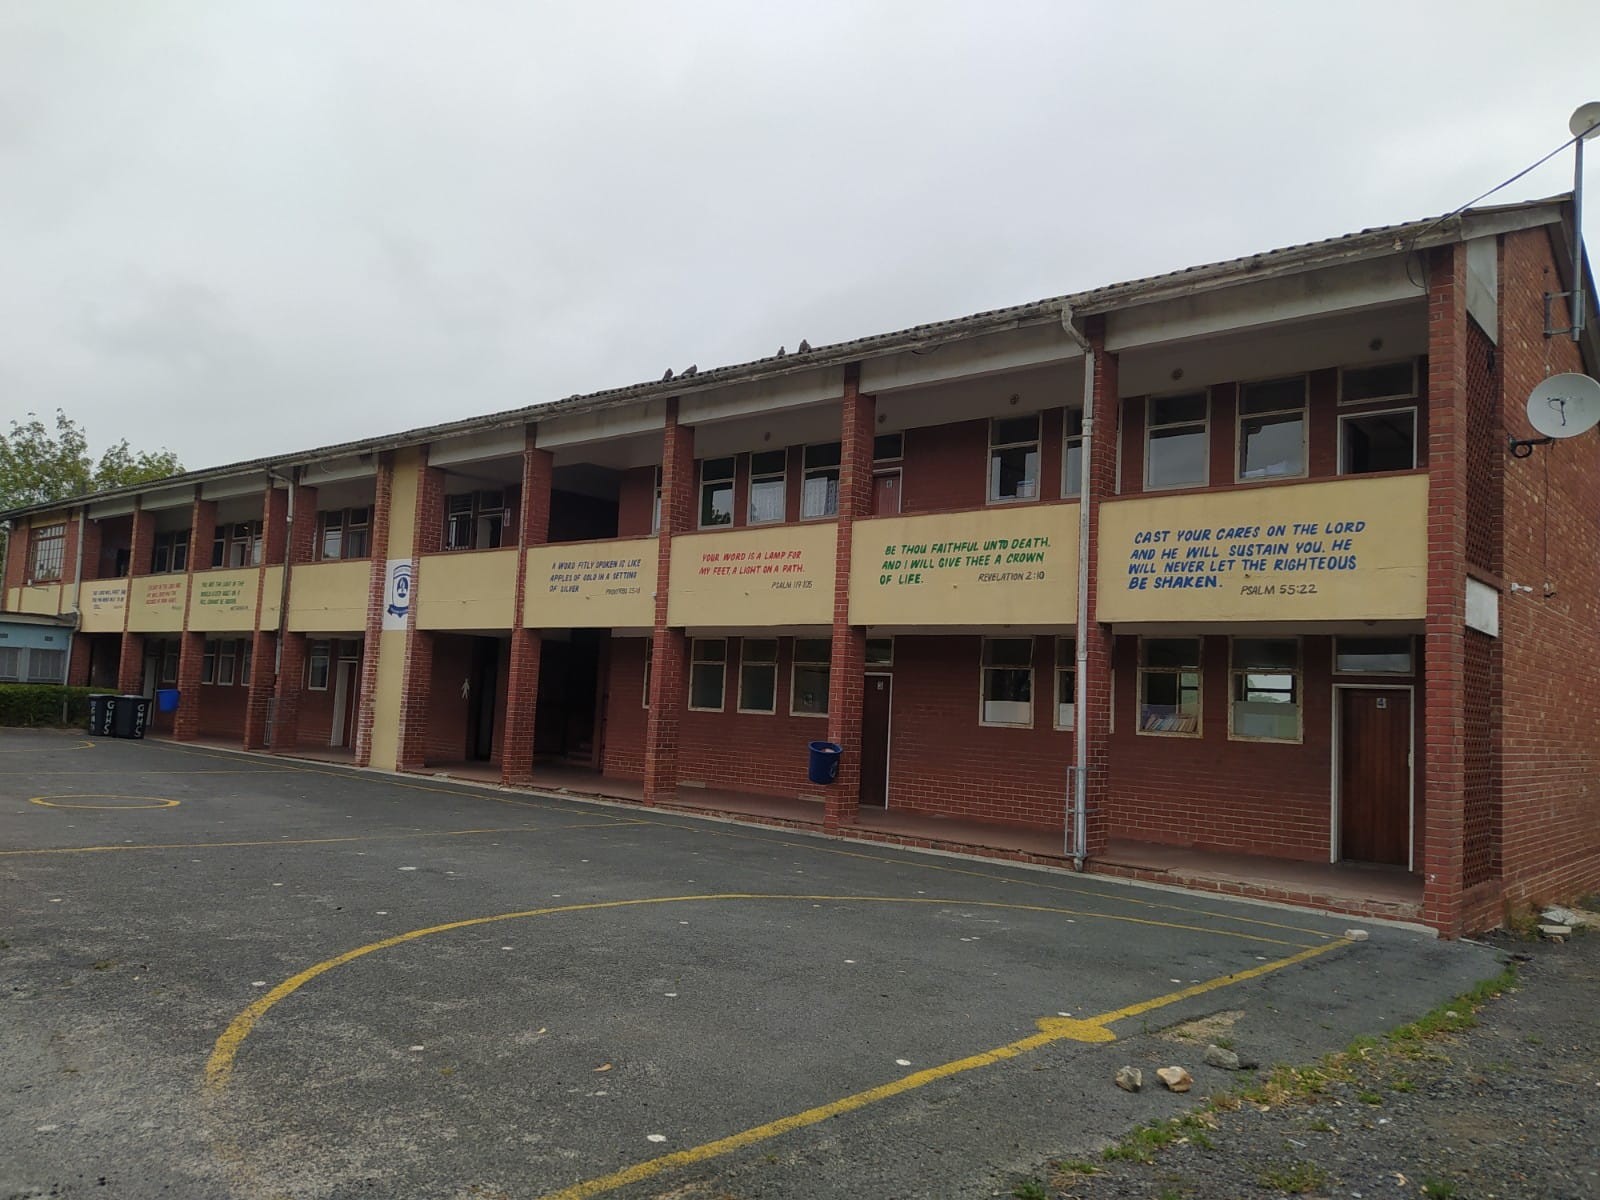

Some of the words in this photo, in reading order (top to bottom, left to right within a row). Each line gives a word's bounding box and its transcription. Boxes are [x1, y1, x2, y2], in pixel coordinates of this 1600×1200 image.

[1135, 530, 1170, 544] CAST
[1178, 529, 1210, 541] YOUR
[1216, 526, 1260, 540] CARES
[1267, 525, 1286, 537] ON
[1293, 524, 1318, 535] THE
[1325, 521, 1366, 533] LORD
[885, 546, 896, 555] BE
[901, 545, 926, 554] THOU
[931, 542, 978, 553] FAITHFUL
[983, 539, 1008, 550] UNTO
[1130, 549, 1156, 560] AND
[1162, 548, 1179, 559] HE
[1186, 546, 1219, 558] WILL
[1229, 543, 1289, 556] SUSTAIN
[1332, 539, 1352, 551] HE
[702, 553, 719, 562] YOUR
[748, 552, 755, 560] IS
[765, 551, 785, 559] LAMP
[787, 551, 801, 559] FOR
[882, 560, 901, 569] AND
[904, 560, 907, 569] I
[910, 558, 934, 569] WILL
[938, 557, 961, 568] GIVE
[965, 555, 990, 566] THEE
[995, 555, 1001, 564] A
[1006, 552, 1044, 564] CROWN
[577, 561, 594, 570] FITLY
[628, 559, 641, 567] LIKE
[699, 567, 710, 575] MY
[739, 566, 761, 574] LIGHT
[763, 564, 772, 573] ON
[782, 564, 805, 572] PATH.
[1128, 562, 1156, 574] WILL
[1164, 561, 1204, 573] NEVER
[1210, 559, 1236, 572] LET
[1242, 559, 1267, 571] THE
[1274, 555, 1356, 570] RIGHTEOUS
[880, 574, 892, 585] OF
[898, 574, 923, 584] LIFE.
[978, 573, 1023, 582] REVELATION
[1026, 571, 1045, 580] 2:10
[1128, 577, 1148, 590] BE
[1154, 575, 1223, 589] SHAKEN.
[1240, 586, 1275, 595] PSALM
[1280, 584, 1318, 595] 55:22
